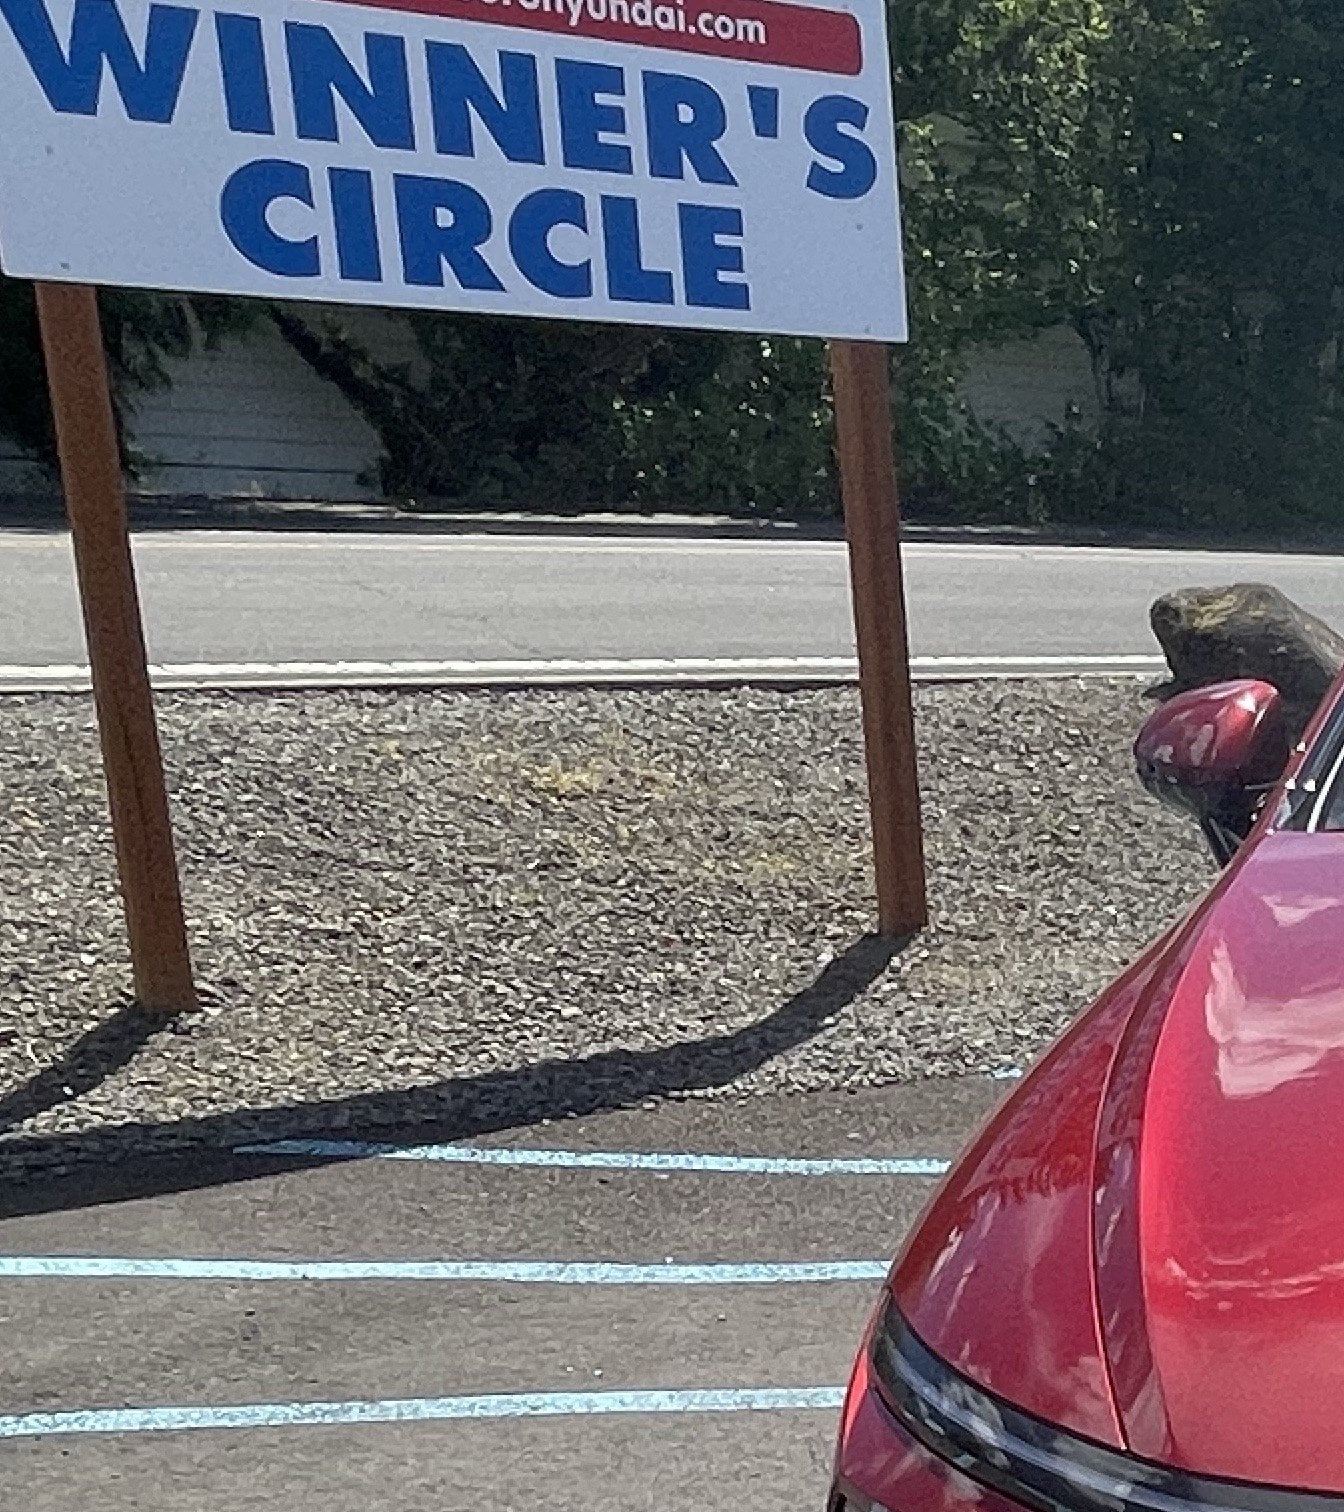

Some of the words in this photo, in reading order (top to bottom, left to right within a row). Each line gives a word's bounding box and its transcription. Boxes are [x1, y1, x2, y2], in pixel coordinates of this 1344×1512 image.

[474, 0, 766, 44] yundai.com
[0, 0, 878, 199] WINNER'S
[220, 158, 751, 311] CIRCLE
